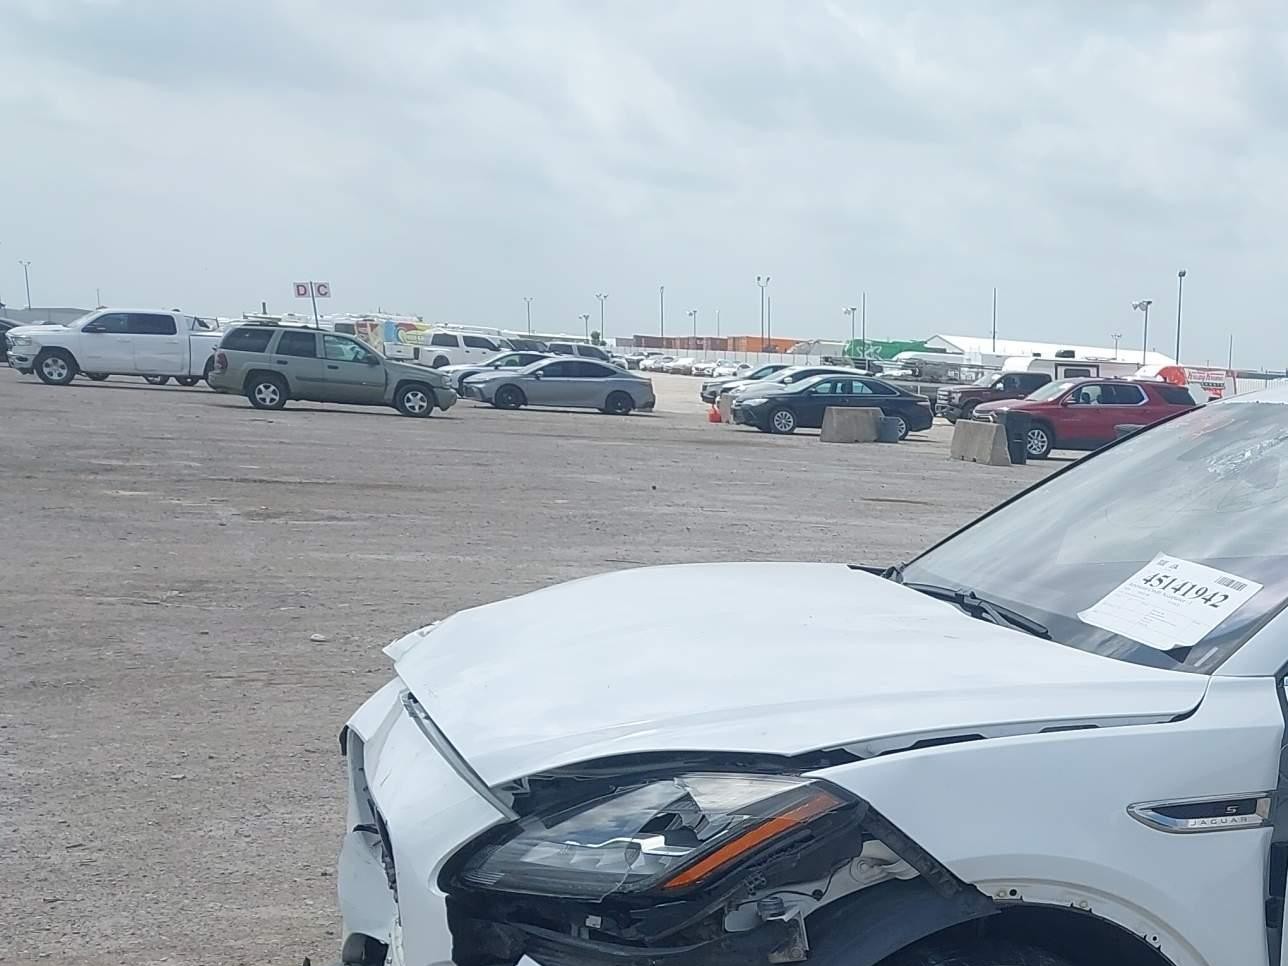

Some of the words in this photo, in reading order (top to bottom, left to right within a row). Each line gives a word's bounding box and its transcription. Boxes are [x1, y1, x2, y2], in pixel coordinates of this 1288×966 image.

[296, 285, 306, 296] D
[317, 284, 328, 296] C
[1143, 573, 1229, 608] 45141942
[1226, 805, 1238, 814] S
[1190, 817, 1249, 827] JAGUAR
